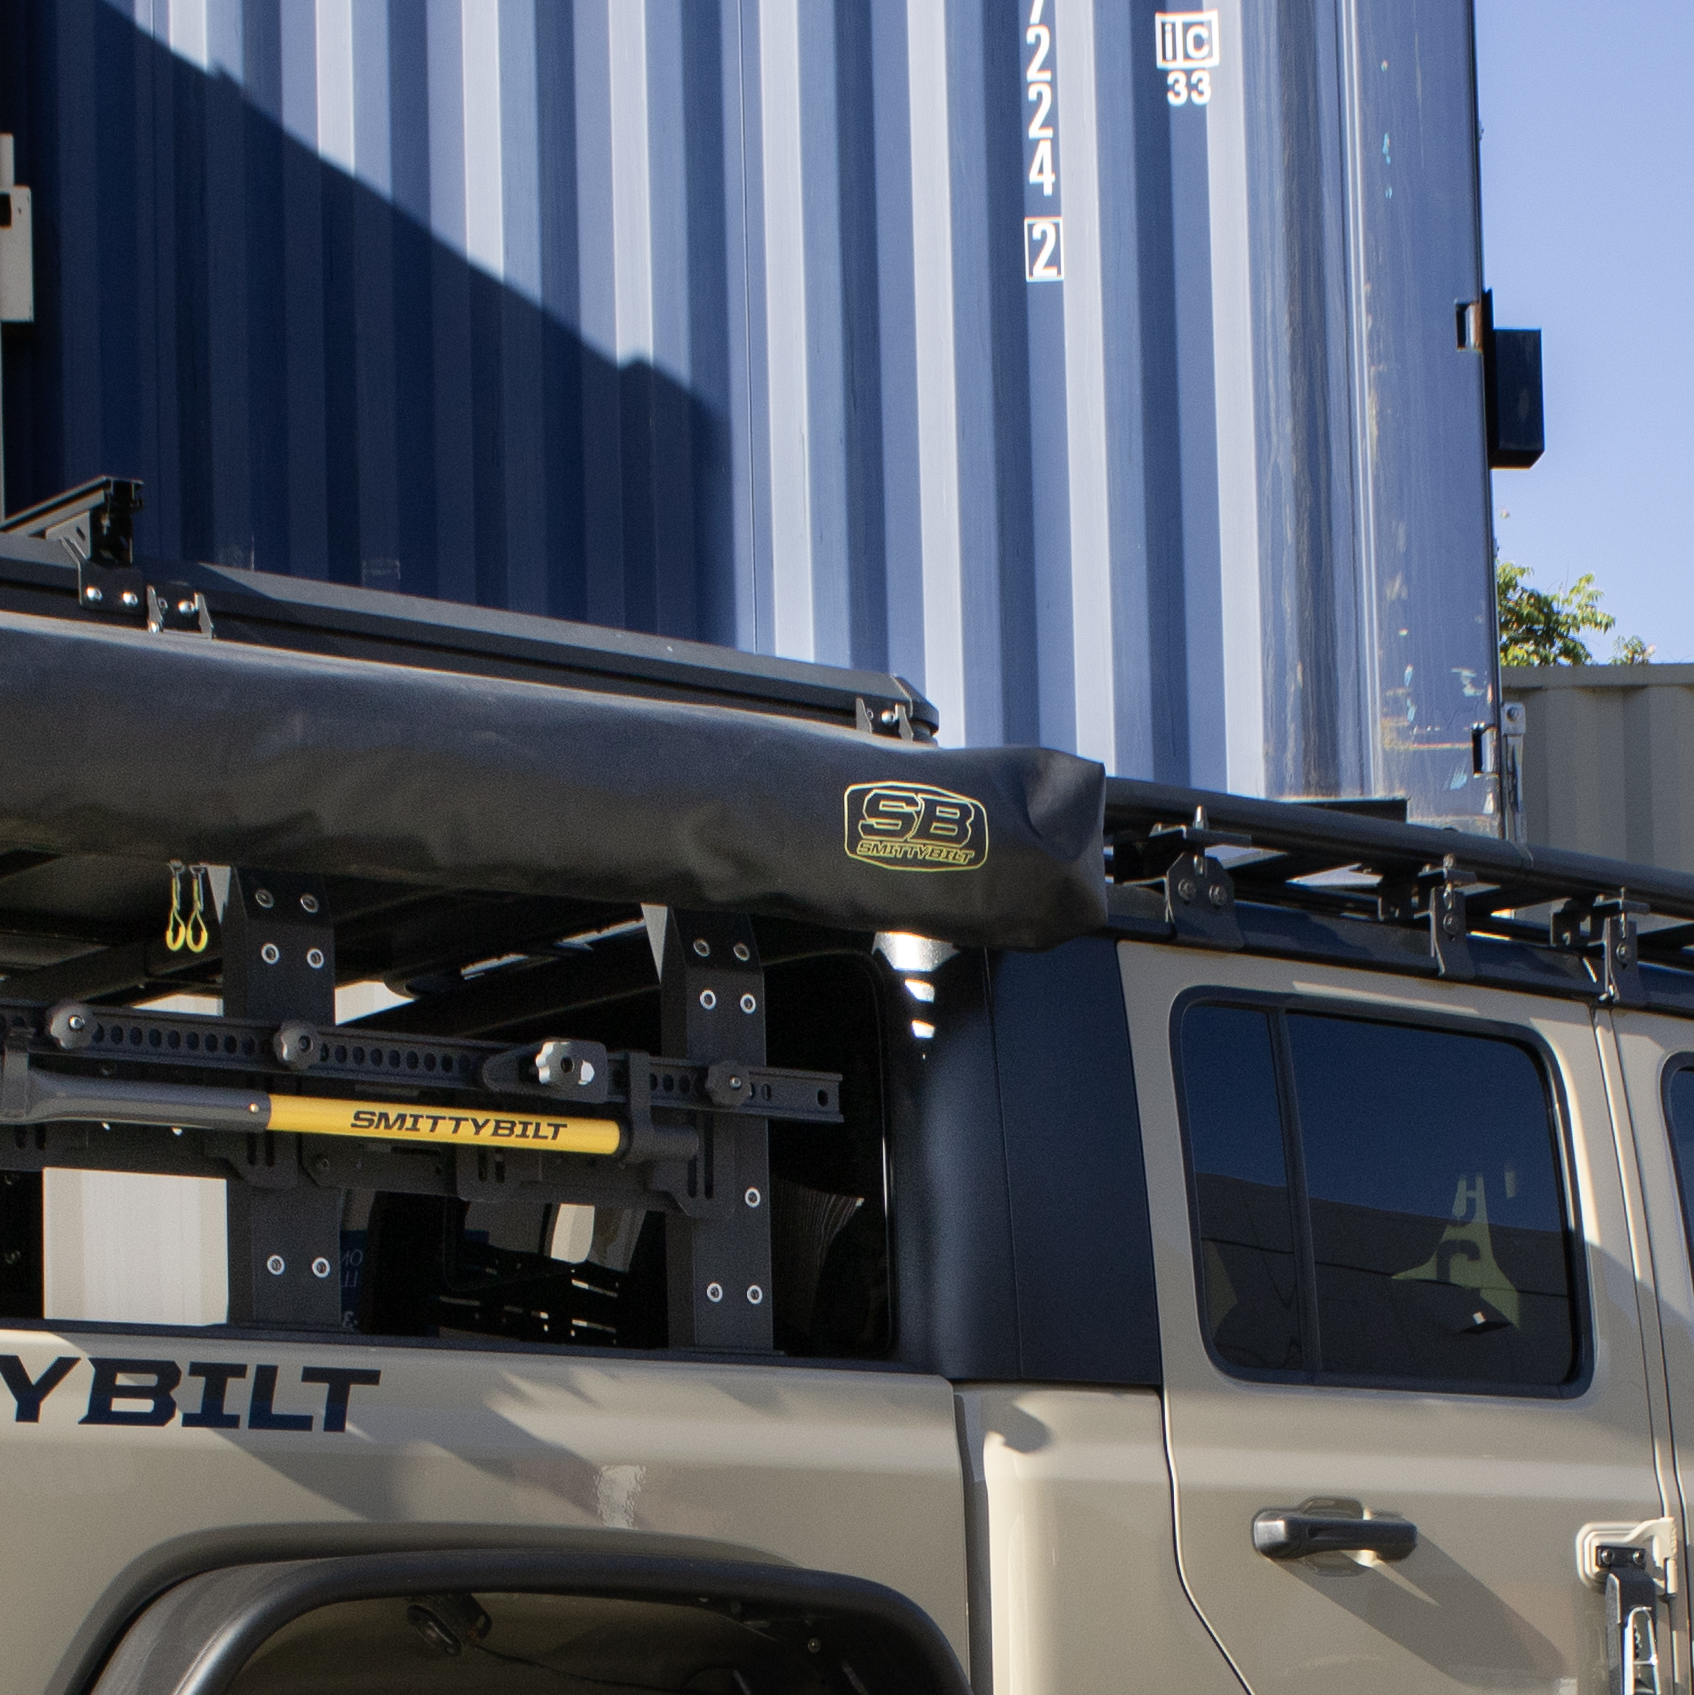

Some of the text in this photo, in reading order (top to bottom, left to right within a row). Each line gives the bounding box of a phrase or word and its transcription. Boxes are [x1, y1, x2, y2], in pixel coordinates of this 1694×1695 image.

[1167, 69, 1211, 106] 33
[857, 788, 975, 849] SB
[856, 839, 975, 865] SMITTYBILT
[350, 1109, 568, 1142] SMITTYBILT
